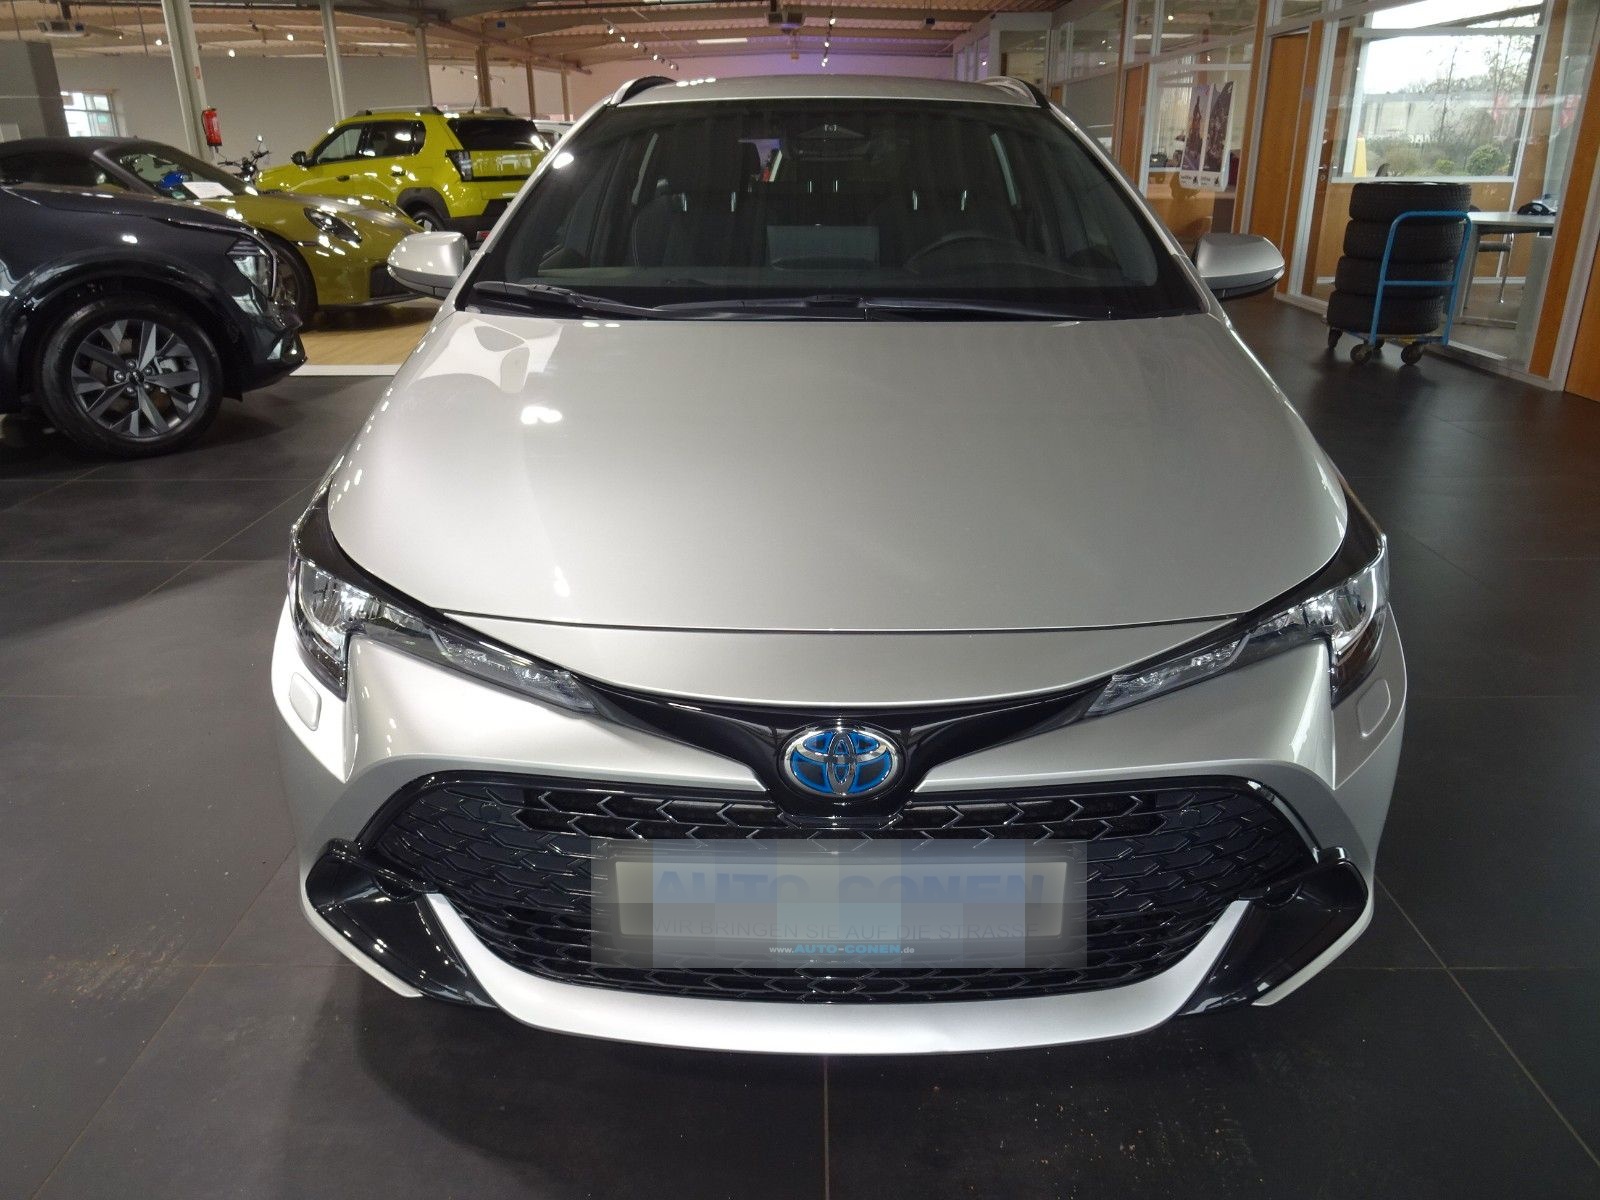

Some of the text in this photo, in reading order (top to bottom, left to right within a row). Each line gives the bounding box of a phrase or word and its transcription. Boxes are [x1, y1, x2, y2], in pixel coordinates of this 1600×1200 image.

[654, 918, 1041, 940] WIR BRINGEN SIE AUF DIE STRASSE
[768, 943, 915, 954] www.AUTO-CONEN.de
